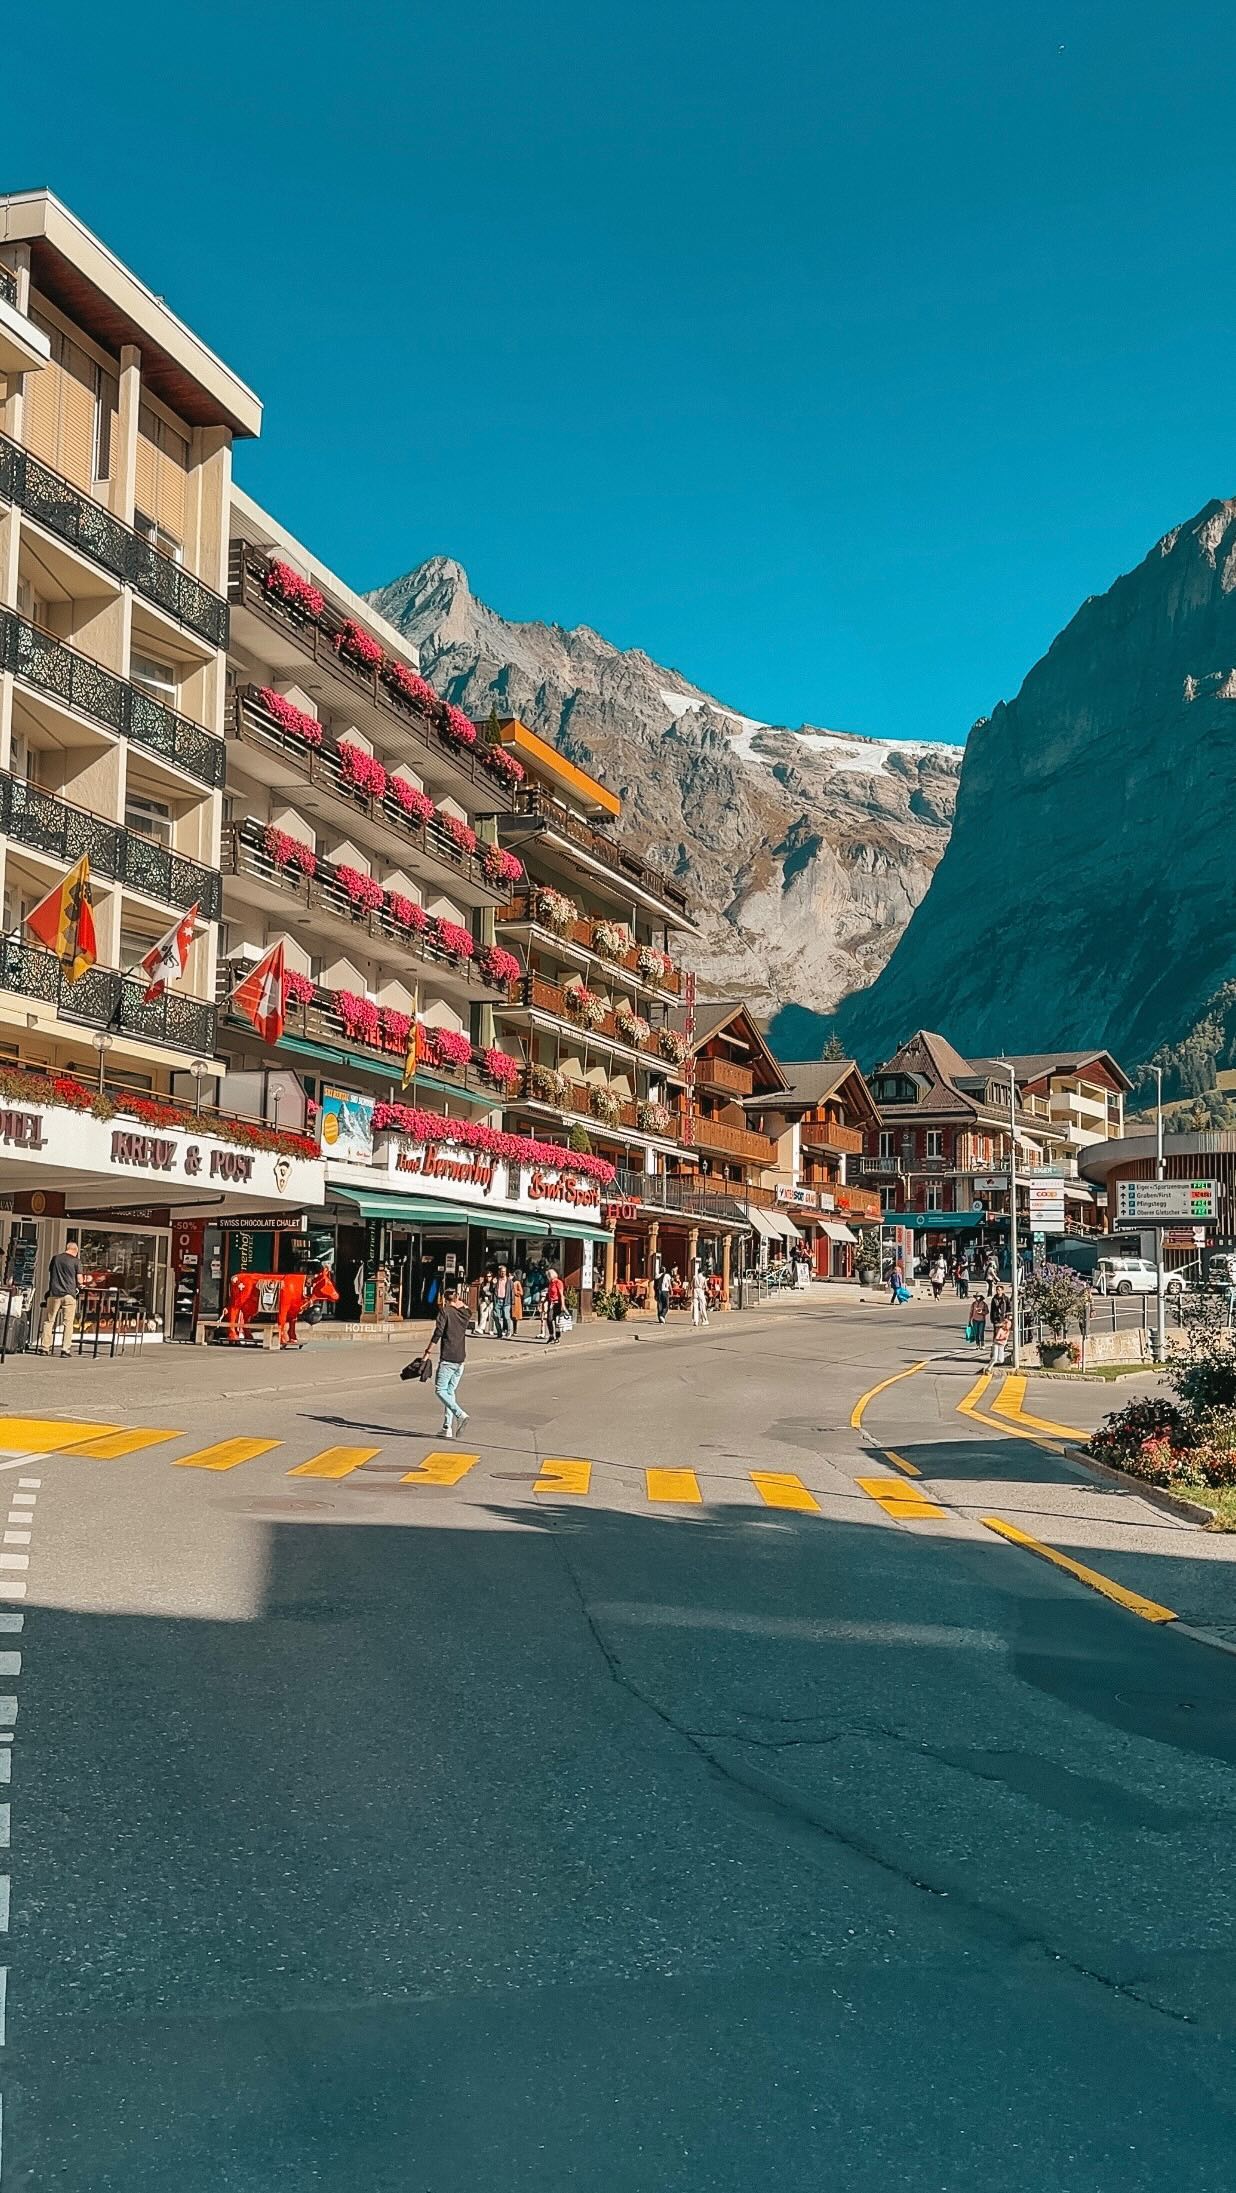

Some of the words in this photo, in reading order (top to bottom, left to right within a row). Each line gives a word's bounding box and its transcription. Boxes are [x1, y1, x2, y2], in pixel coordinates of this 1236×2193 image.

[0, 1109, 48, 1151] TEL
[110, 1130, 177, 1172] KREUZ
[184, 1145, 203, 1176] &
[210, 1150, 256, 1184] POST
[173, 1221, 197, 1230] -50%
[220, 1219, 239, 1227] SWISS
[240, 1219, 276, 1228] CHOCOLATE
[276, 1219, 300, 1228] CHALET
[239, 1231, 250, 1271] nerhof
[345, 1323, 376, 1333] HOTEL
